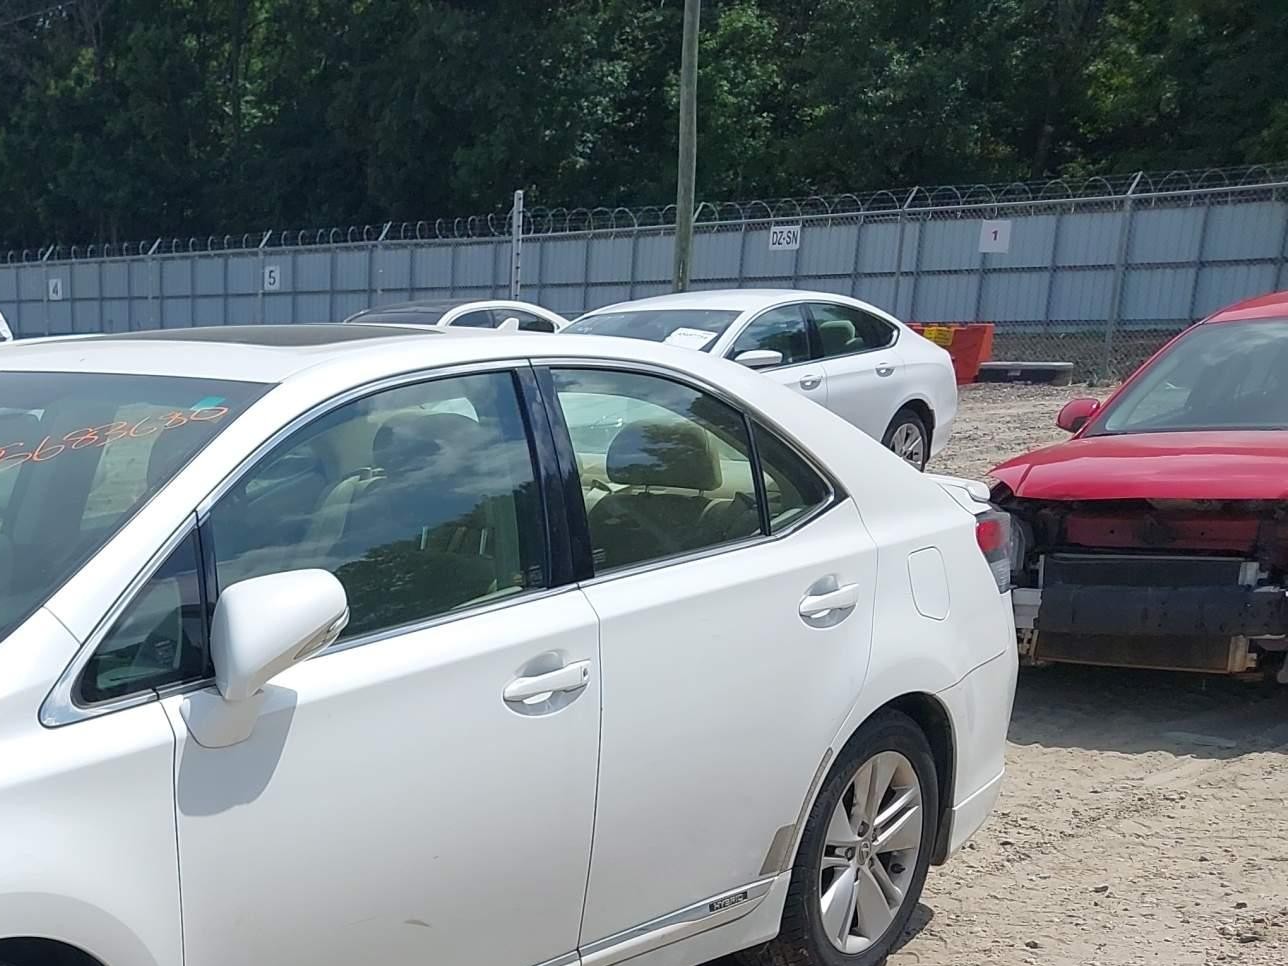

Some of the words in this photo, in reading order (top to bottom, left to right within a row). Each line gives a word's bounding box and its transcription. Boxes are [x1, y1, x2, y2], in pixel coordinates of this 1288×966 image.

[771, 230, 799, 246] DZ-SN
[267, 269, 277, 286] 5
[51, 282, 60, 296] 4
[713, 893, 744, 911] HYBRID
